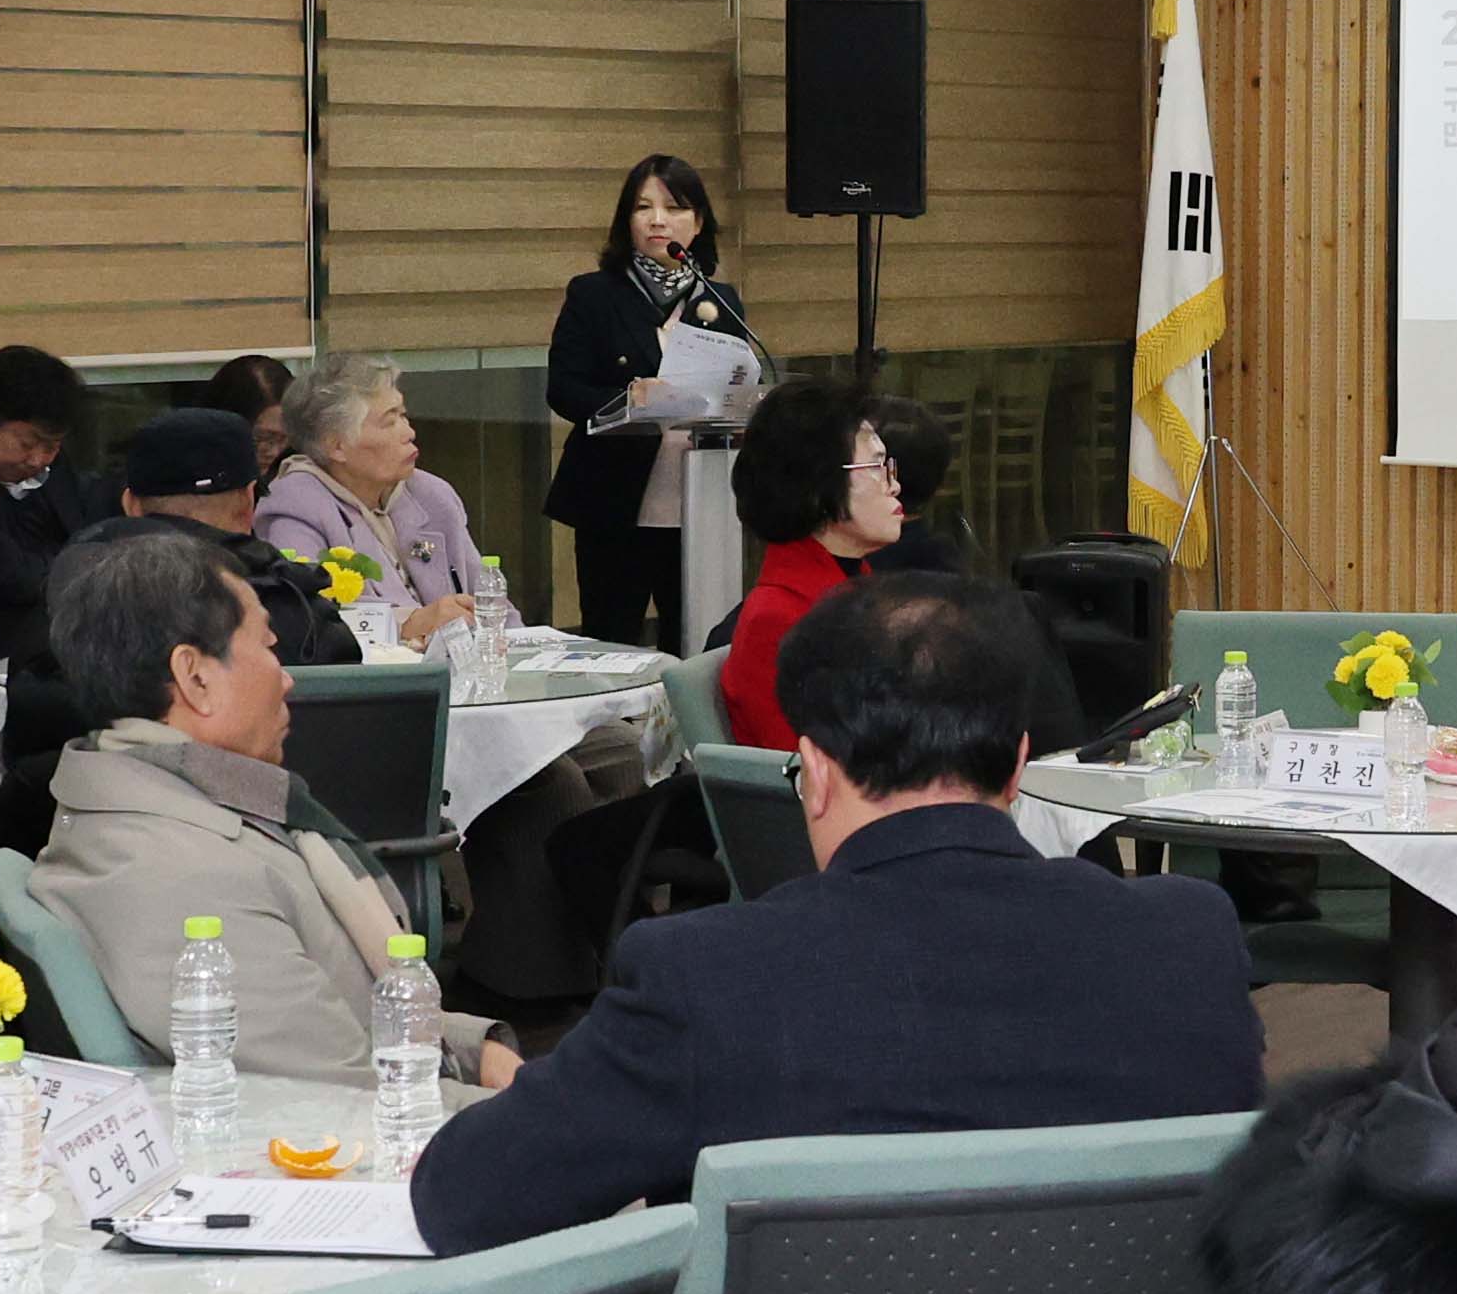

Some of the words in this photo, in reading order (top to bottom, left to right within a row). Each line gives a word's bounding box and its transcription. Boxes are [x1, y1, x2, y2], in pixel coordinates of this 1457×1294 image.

[1288, 741, 1339, 757] 구청장
[1284, 758, 1375, 788] 김찬진
[89, 1129, 160, 1199] 오병규
